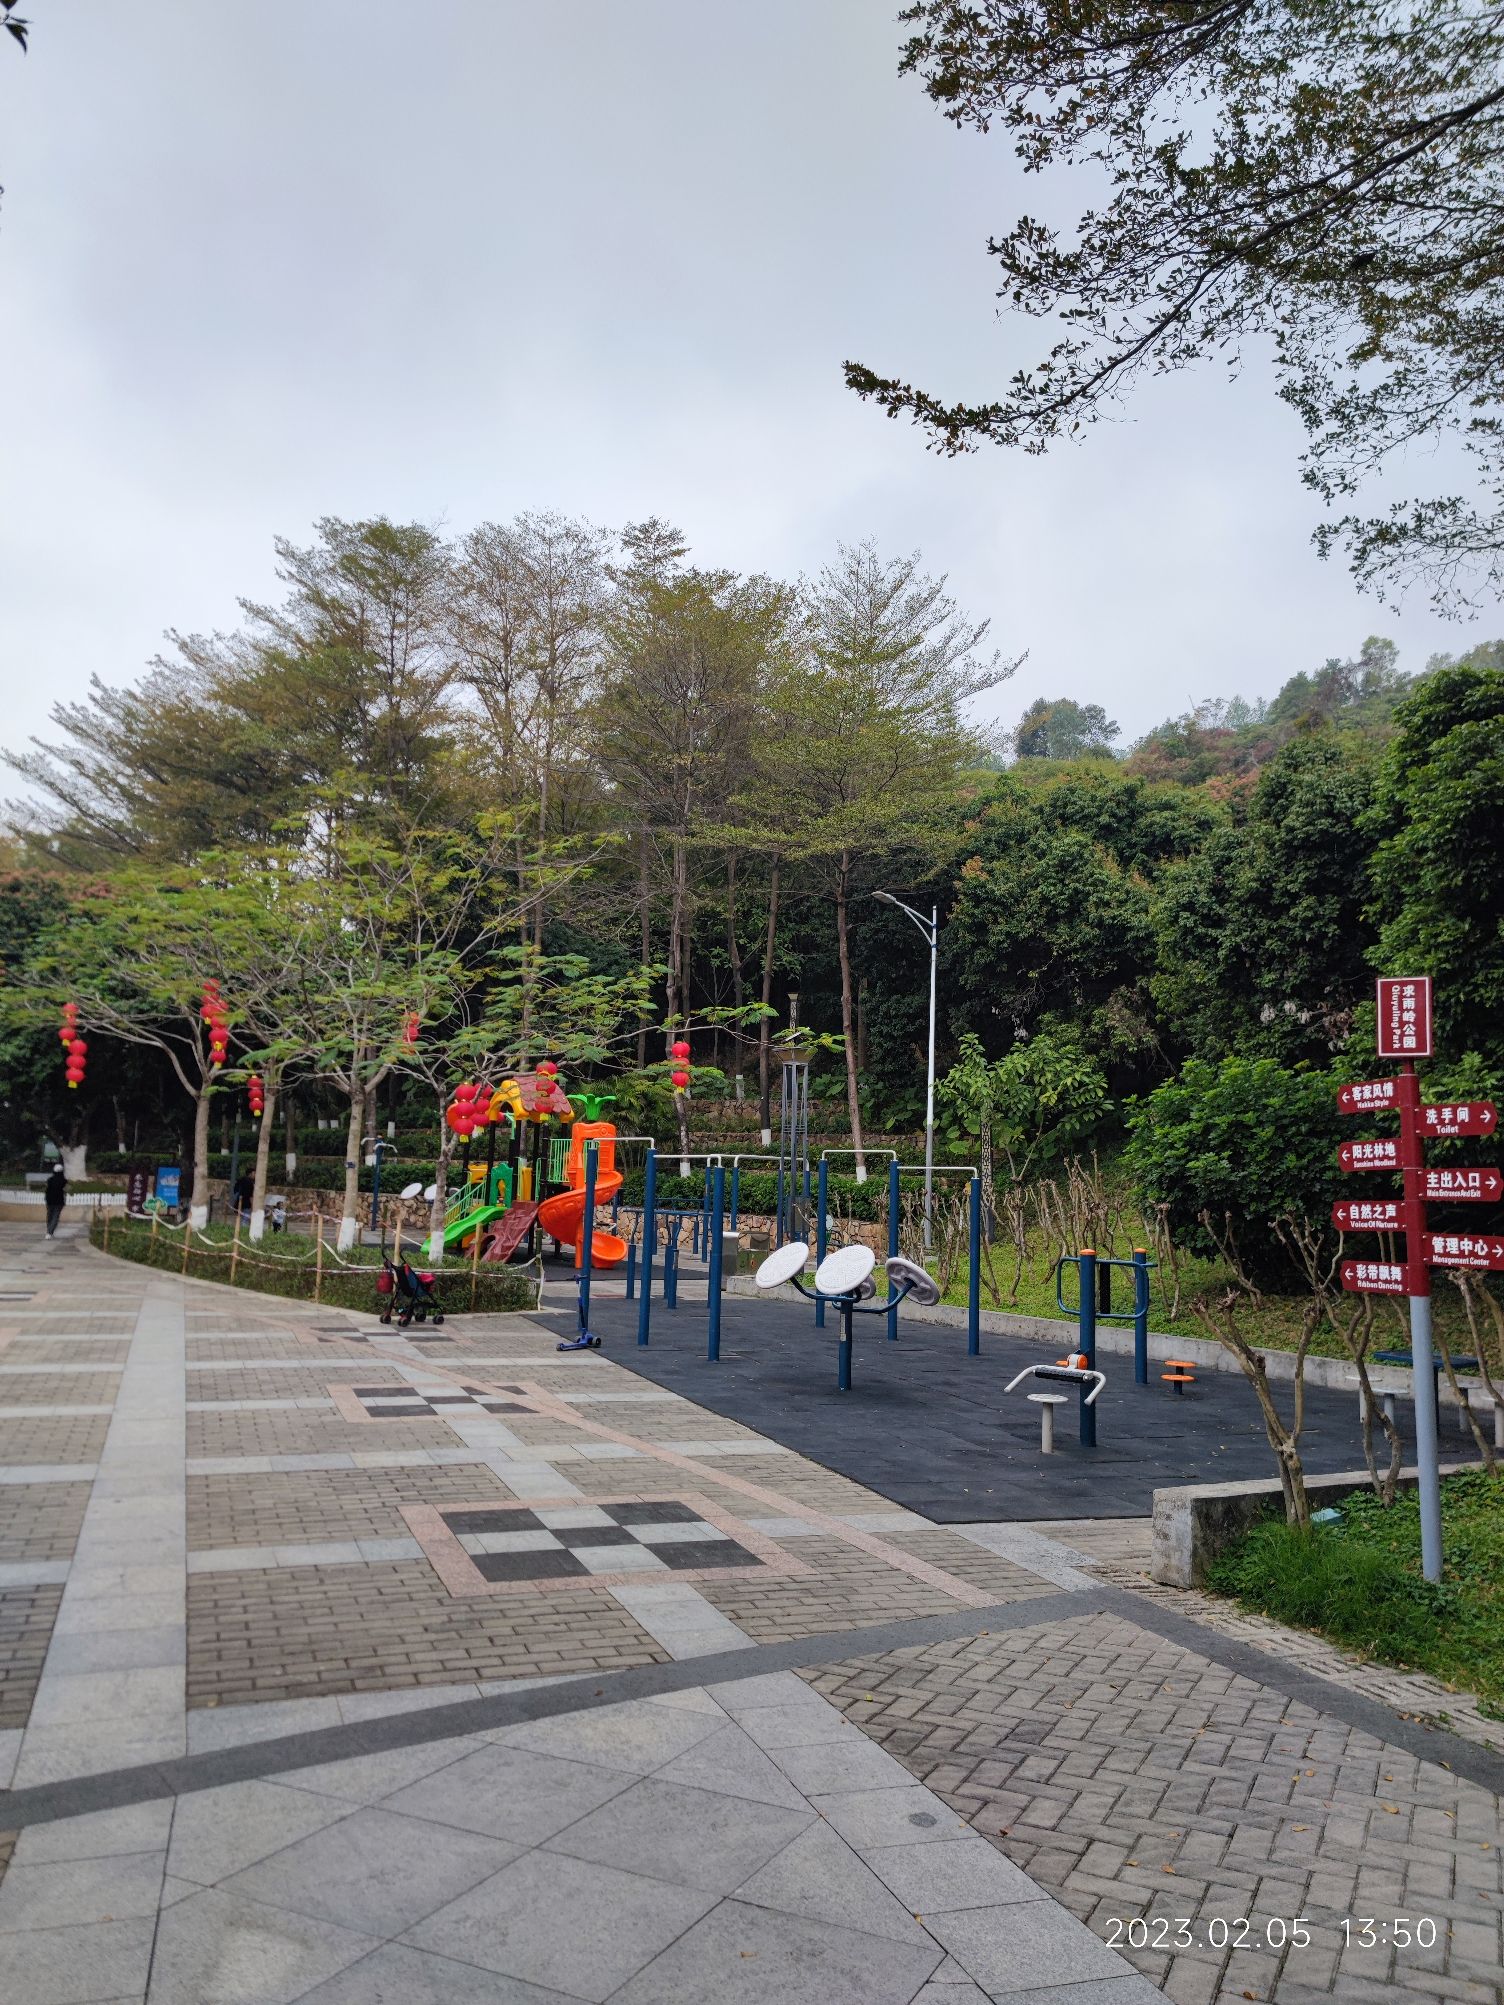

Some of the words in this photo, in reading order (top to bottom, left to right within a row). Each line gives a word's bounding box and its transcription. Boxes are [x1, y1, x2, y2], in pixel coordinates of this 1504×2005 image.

[1391, 985, 1401, 1028] Qiuyuling
[1402, 984, 1416, 1049] 求雨岭公园
[1392, 1029, 1401, 1049] Park
[1352, 1082, 1394, 1101] 客家风情
[1426, 1106, 1470, 1124] 洗手间
[1436, 1125, 1459, 1134] Toilet
[1352, 1141, 1396, 1159] 阳光林地
[1426, 1171, 1480, 1188] 主出入口
[1350, 1203, 1397, 1219] 自然之声
[1350, 1220, 1368, 1228] Voice
[1368, 1220, 1376, 1228] Of
[1376, 1220, 1399, 1229] Nature
[1432, 1236, 1488, 1256] 管理中心
[1432, 1254, 1470, 1265] Management
[1356, 1264, 1402, 1281] 彩带飘舞
[1357, 1280, 1378, 1289] Ribbon
[1378, 1281, 1403, 1291] Dancing
